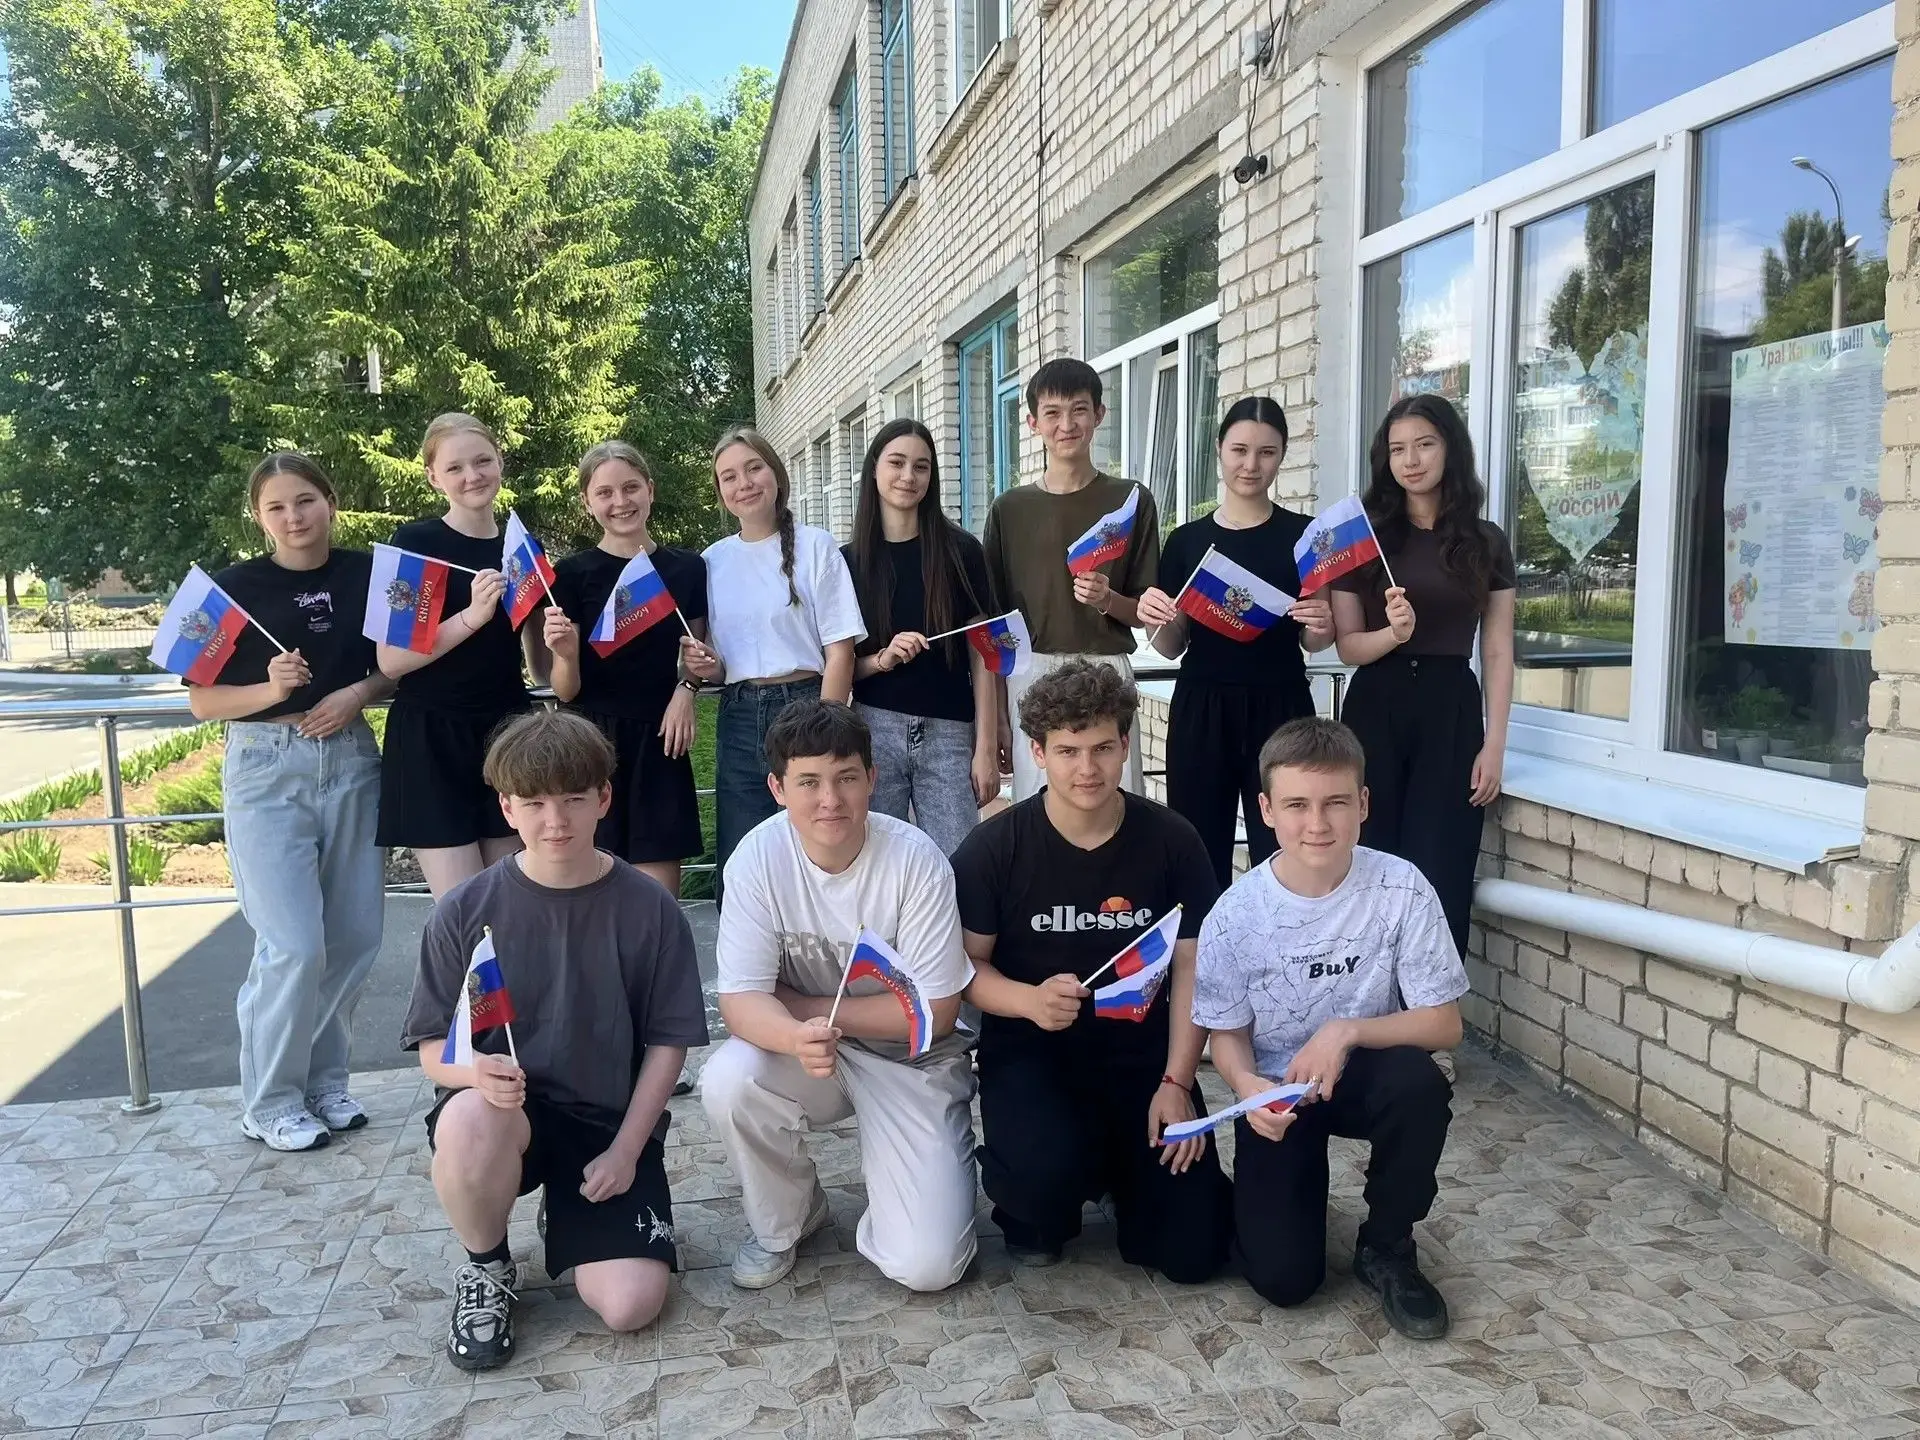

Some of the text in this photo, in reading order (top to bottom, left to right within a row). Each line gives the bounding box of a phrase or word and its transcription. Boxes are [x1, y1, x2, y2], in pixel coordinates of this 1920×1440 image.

[1760, 343, 1785, 370] Ура!
[1206, 603, 1245, 631] РОССИЯ
[1030, 905, 1153, 933] ellesse
